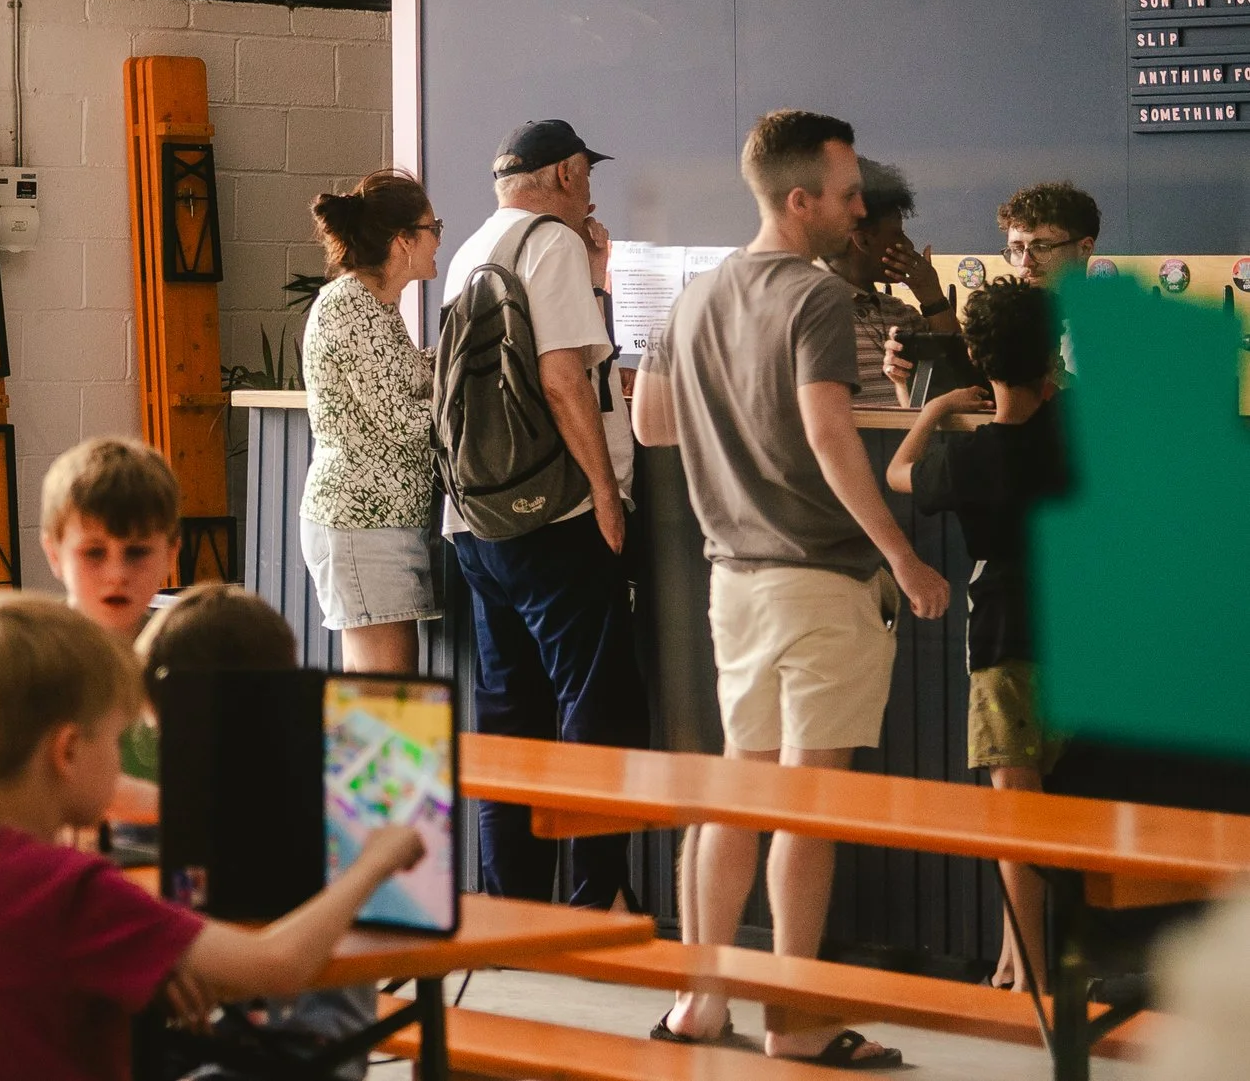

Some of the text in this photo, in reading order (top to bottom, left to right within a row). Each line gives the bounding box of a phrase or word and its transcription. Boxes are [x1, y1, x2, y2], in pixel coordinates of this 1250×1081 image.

[1136, 32, 1177, 47] SLIP
[1138, 68, 1223, 85] ANYTHING
[1140, 105, 1235, 122] SOMETHING
